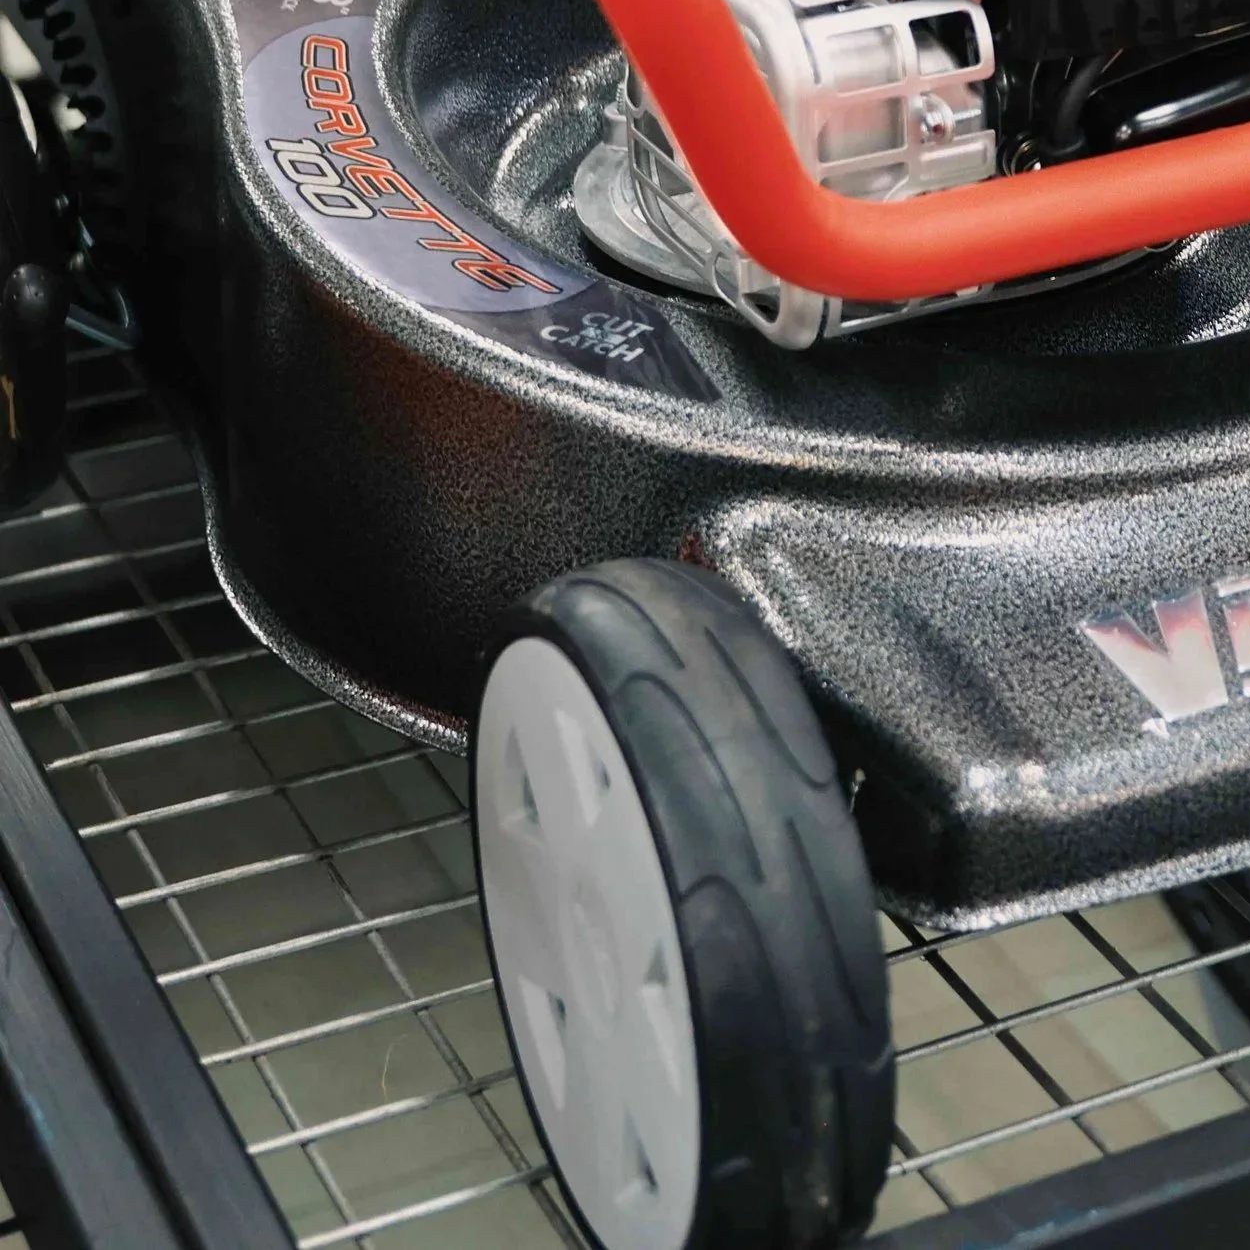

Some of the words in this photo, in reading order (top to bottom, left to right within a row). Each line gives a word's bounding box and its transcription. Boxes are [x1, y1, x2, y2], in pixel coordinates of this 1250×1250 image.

[266, 137, 378, 220] 100
[302, 34, 563, 295] CORVETTE
[540, 325, 645, 362] CATCH
[582, 312, 655, 338] CUT
